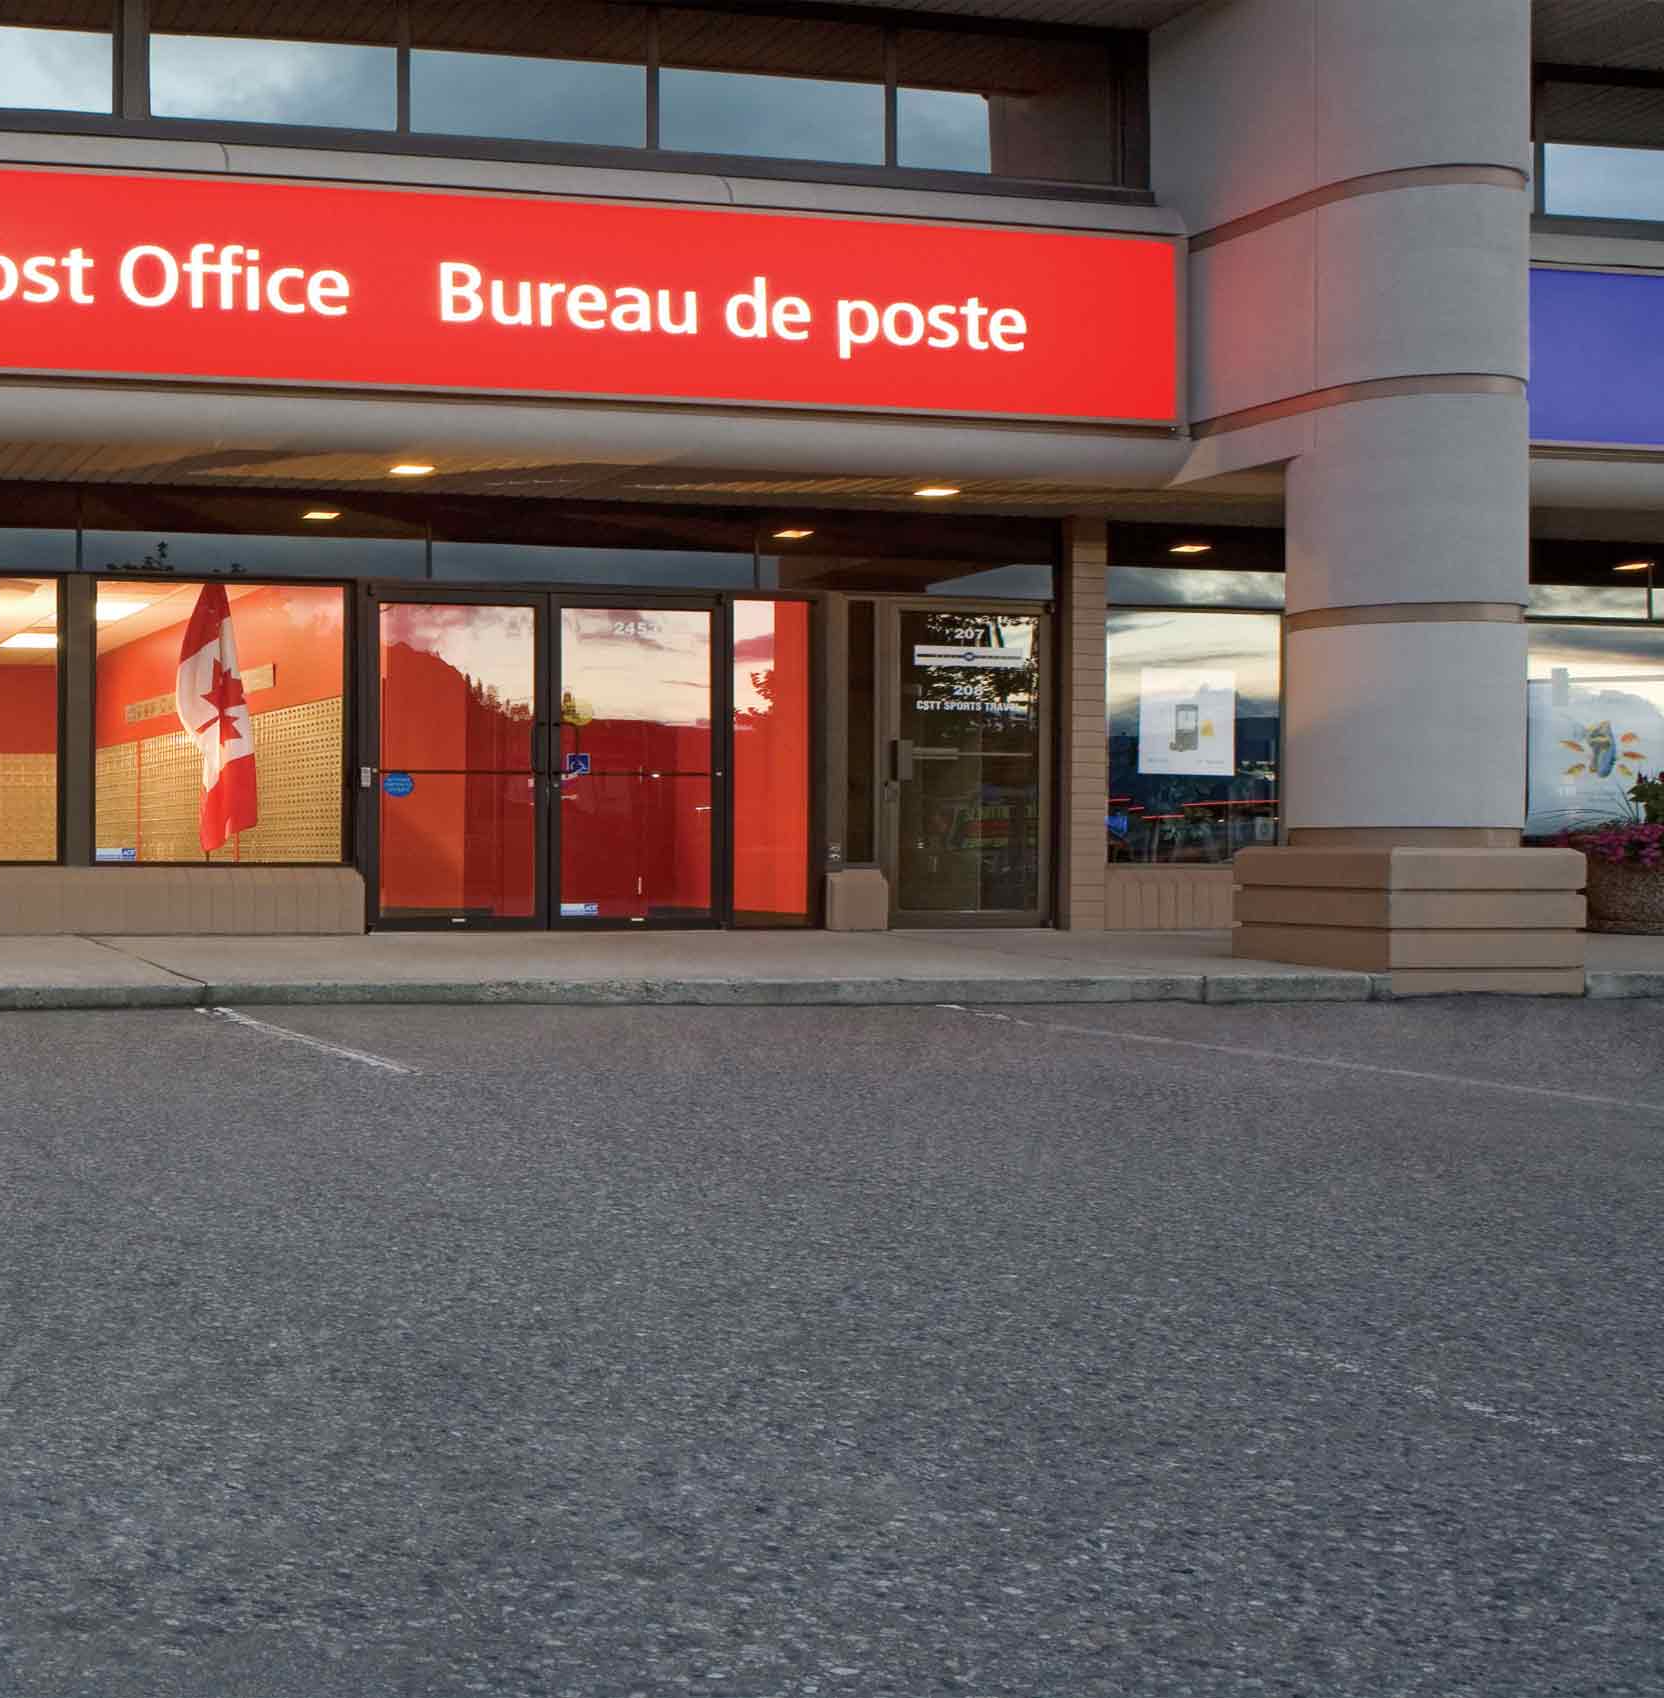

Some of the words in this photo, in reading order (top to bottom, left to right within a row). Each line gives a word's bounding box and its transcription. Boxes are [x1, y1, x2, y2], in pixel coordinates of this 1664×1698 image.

[118, 242, 351, 318] Office
[438, 259, 699, 336] Bureau
[723, 275, 812, 342] de
[836, 296, 1028, 361] poste
[954, 627, 985, 640] 207
[943, 701, 982, 712] SPORTS
[984, 702, 1019, 712] TRAV
